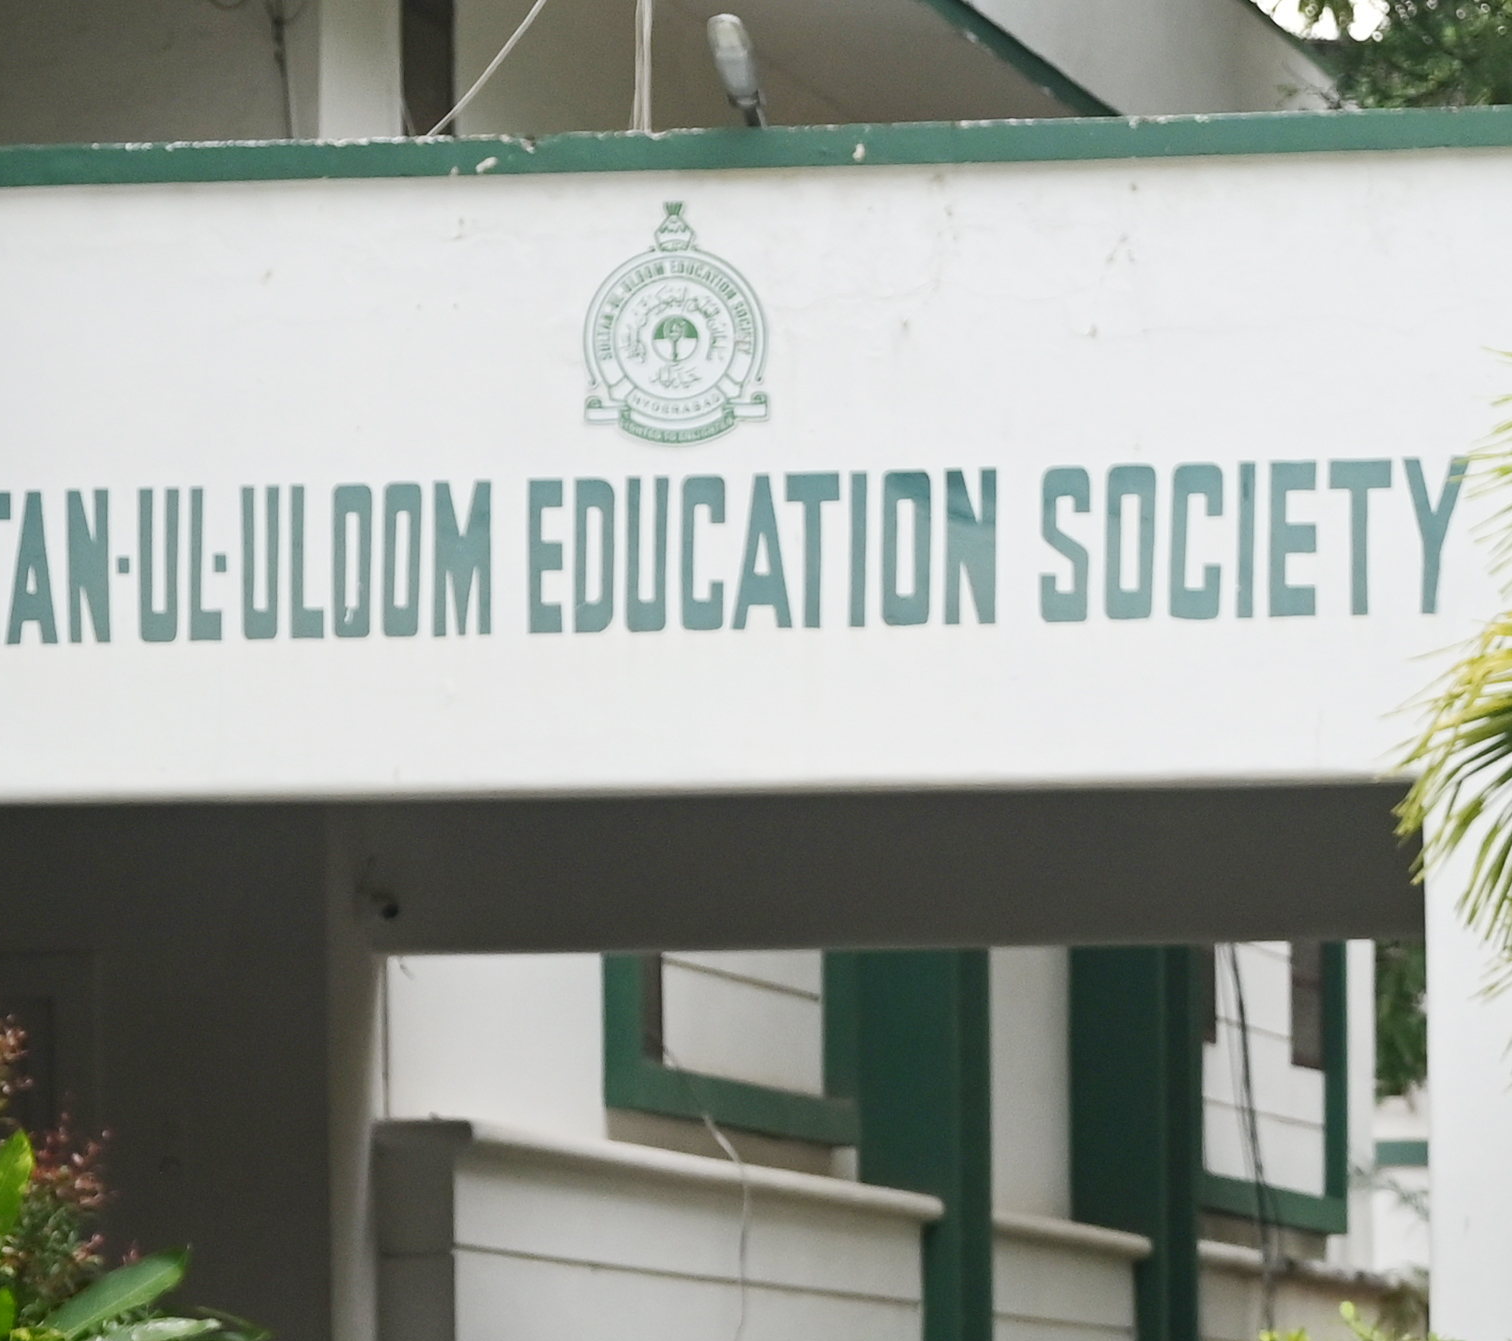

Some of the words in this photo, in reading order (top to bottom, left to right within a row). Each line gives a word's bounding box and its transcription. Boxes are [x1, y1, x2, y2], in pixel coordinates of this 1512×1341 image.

[669, 260, 737, 300] EDUCATION
[529, 469, 997, 634] EDUCATION
[1041, 459, 1469, 623] SOCIETY
